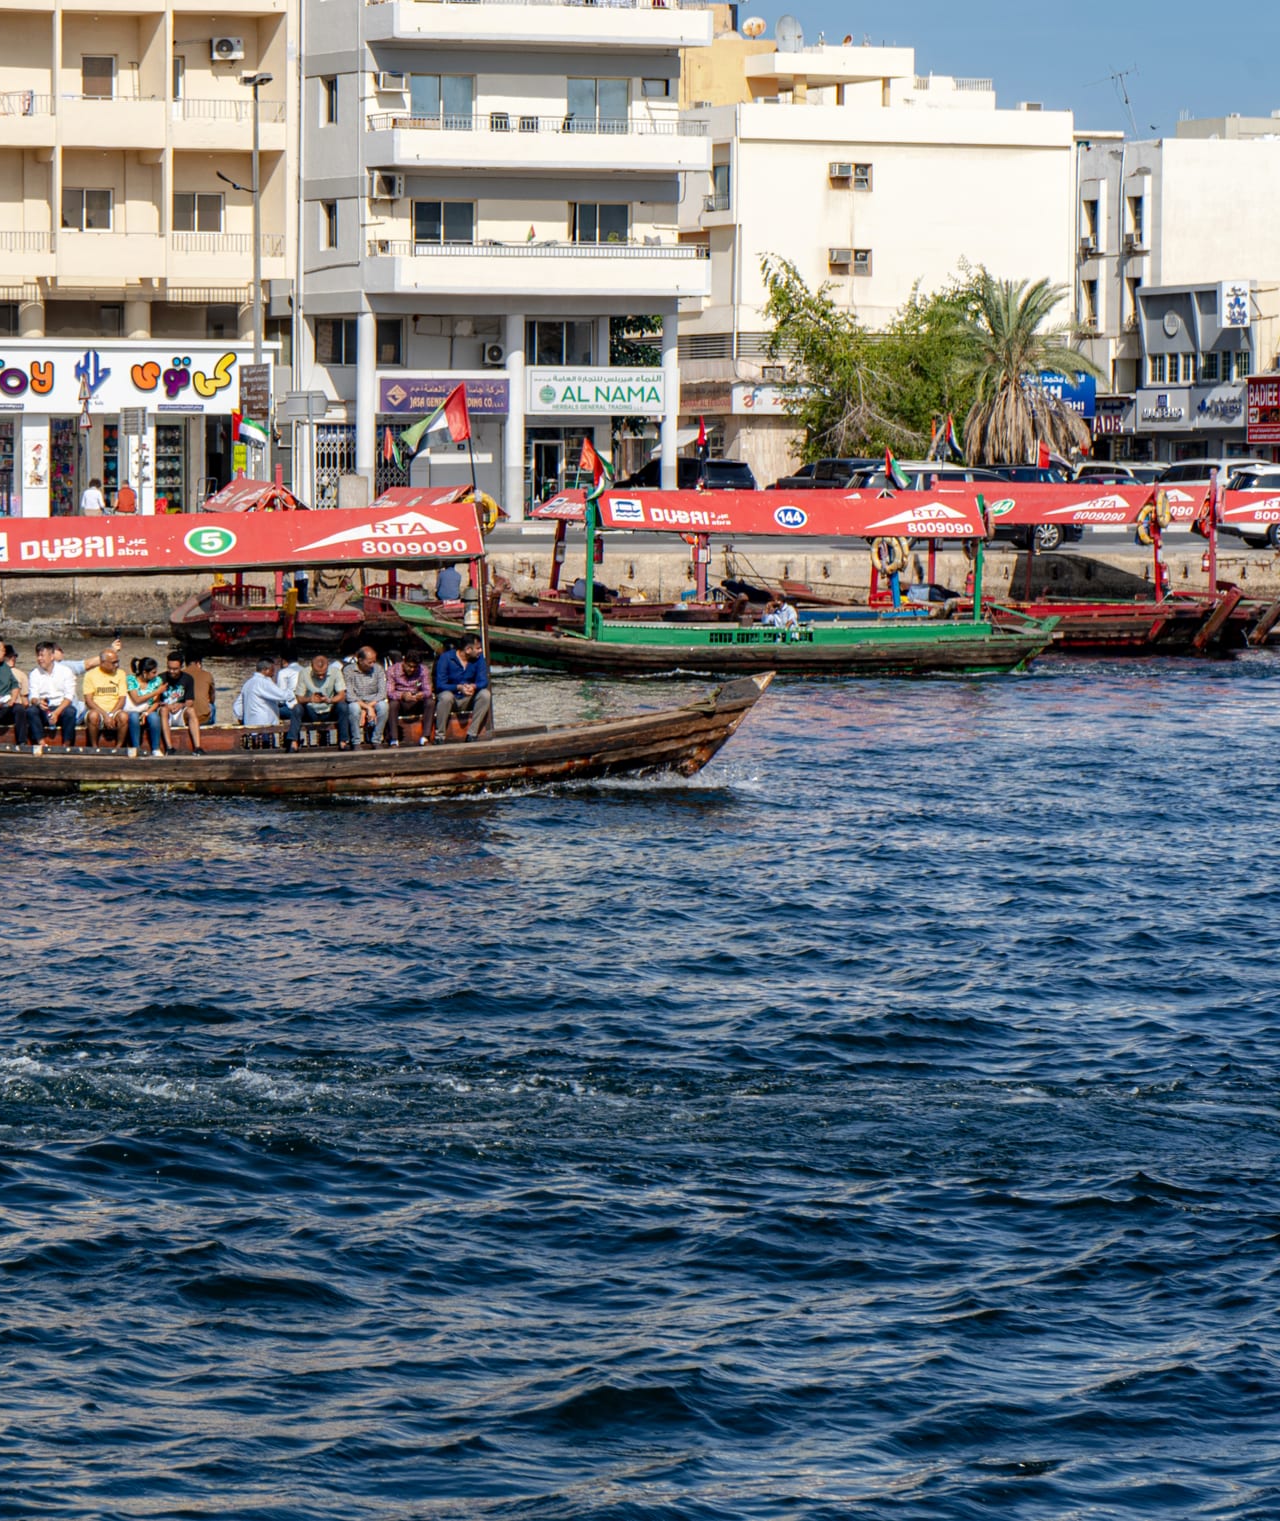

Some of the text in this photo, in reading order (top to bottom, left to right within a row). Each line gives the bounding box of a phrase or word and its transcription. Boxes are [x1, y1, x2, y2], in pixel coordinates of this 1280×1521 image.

[561, 386, 661, 402] AL NAMA
[1250, 383, 1278, 406] BADIEE
[1087, 499, 1117, 508] RTA
[649, 507, 710, 526] DUBAI
[778, 510, 802, 524] 144
[911, 509, 949, 518] RTA
[1073, 511, 1126, 521] 8009090
[370, 522, 431, 534] RTA
[907, 522, 973, 534] 8009090
[20, 536, 114, 561] DUBAI
[200, 532, 221, 551] 5
[362, 539, 467, 555] 8009090
[117, 548, 149, 556] abra
